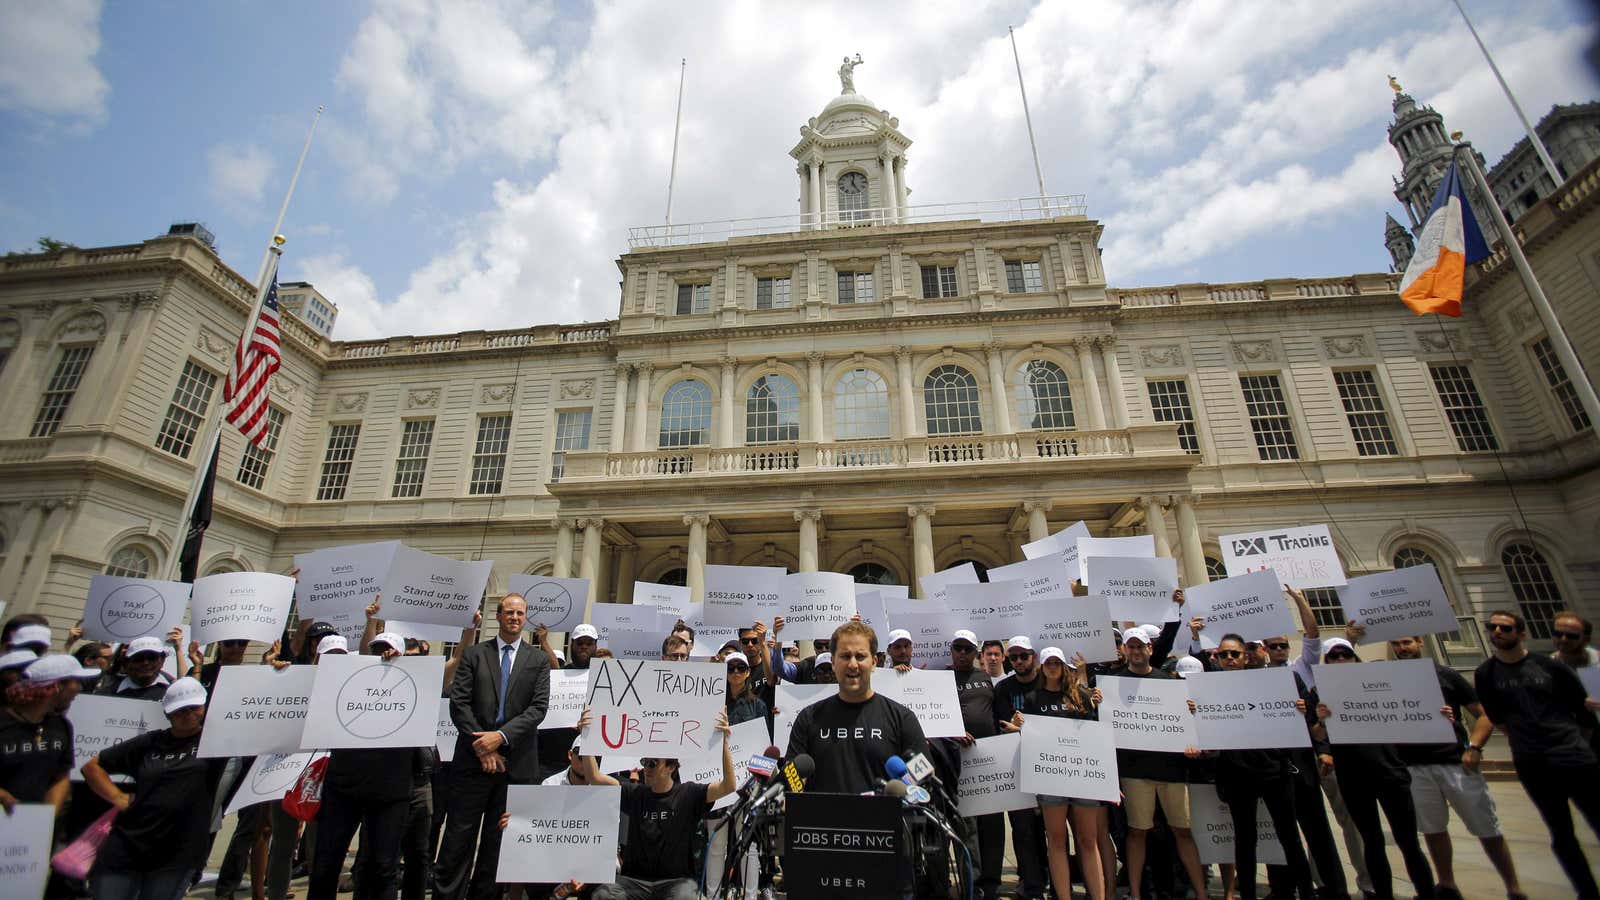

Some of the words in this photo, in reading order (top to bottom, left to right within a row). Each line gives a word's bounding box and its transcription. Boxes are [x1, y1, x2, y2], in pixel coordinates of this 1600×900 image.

[314, 582, 342, 592] Stand
[345, 580, 358, 590] up
[360, 576, 374, 585] for
[1031, 578, 1050, 587] UBER
[310, 588, 356, 602] Brooklyn
[360, 584, 381, 595] Jobs
[403, 585, 433, 598] Stand
[436, 592, 451, 602] up
[453, 592, 468, 601] for
[1031, 586, 1052, 595] KNOW
[123, 600, 145, 609] TAXI
[393, 595, 442, 609] Brooklyn
[446, 602, 469, 611] Jobs
[790, 604, 813, 612] Stand
[816, 604, 827, 612] up
[1212, 600, 1233, 611] SAVE
[1235, 596, 1260, 606] UBER
[1360, 606, 1386, 616] Don't
[1389, 600, 1431, 612] Destroy
[207, 604, 236, 614] Stand
[241, 605, 254, 613] up
[260, 604, 274, 612] for
[1219, 611, 1233, 620] WE
[1236, 607, 1263, 616] KNOW
[107, 610, 155, 620] BAILOUTS
[786, 615, 825, 624] Brooklyn
[1366, 615, 1405, 625] Queens
[1408, 609, 1433, 619] Jobs
[201, 615, 250, 627] Brooklyn
[254, 615, 277, 625] Jobs
[1044, 622, 1064, 630] SAVE
[1066, 620, 1088, 628] UBER
[1065, 631, 1091, 639] KNOW
[1093, 629, 1101, 637] IT
[588, 660, 644, 706] AX
[654, 670, 724, 697] TRADING
[958, 681, 988, 690] UBER
[366, 688, 392, 697] TAXI
[241, 697, 273, 706] SAVE
[276, 696, 310, 706] UBER
[346, 702, 406, 711] BAILOUTS
[1343, 701, 1378, 710] Stand
[1382, 702, 1398, 710] up
[1402, 700, 1420, 708] for
[225, 711, 240, 720] AS
[245, 711, 265, 720] WE
[268, 710, 308, 720] KNOW
[929, 712, 951, 720] Jobs
[1113, 710, 1138, 719] Don't
[1141, 712, 1181, 723] Destroy
[1340, 712, 1398, 723] Brooklyn
[1400, 712, 1432, 720] Jobs
[601, 714, 701, 749] UBER
[1112, 721, 1157, 732] Brooklyn
[1160, 724, 1184, 733] Jobs
[820, 728, 882, 739] UBER
[76, 734, 109, 746] Don't
[5, 740, 64, 753] UBER
[1040, 753, 1067, 763] Stand
[1070, 757, 1083, 766] up
[1086, 756, 1099, 766] for
[914, 761, 929, 775] 41
[1034, 765, 1079, 777] Brooklyn
[1083, 770, 1106, 779] Jobs
[695, 767, 720, 781] Don't
[978, 770, 1015, 782] Destroy
[994, 781, 1016, 792] Jobs
[531, 819, 557, 828] SAVE
[561, 820, 590, 829] UBER
[518, 834, 532, 844] AS
[536, 835, 552, 844] WE
[556, 834, 590, 844] KNOW
[593, 835, 603, 844] IT
[793, 832, 828, 845] JOBS
[834, 833, 860, 846] FOR
[866, 836, 893, 848] NYC
[5, 846, 29, 856] UBER
[30, 862, 39, 872] IT
[820, 877, 865, 888] UBER
